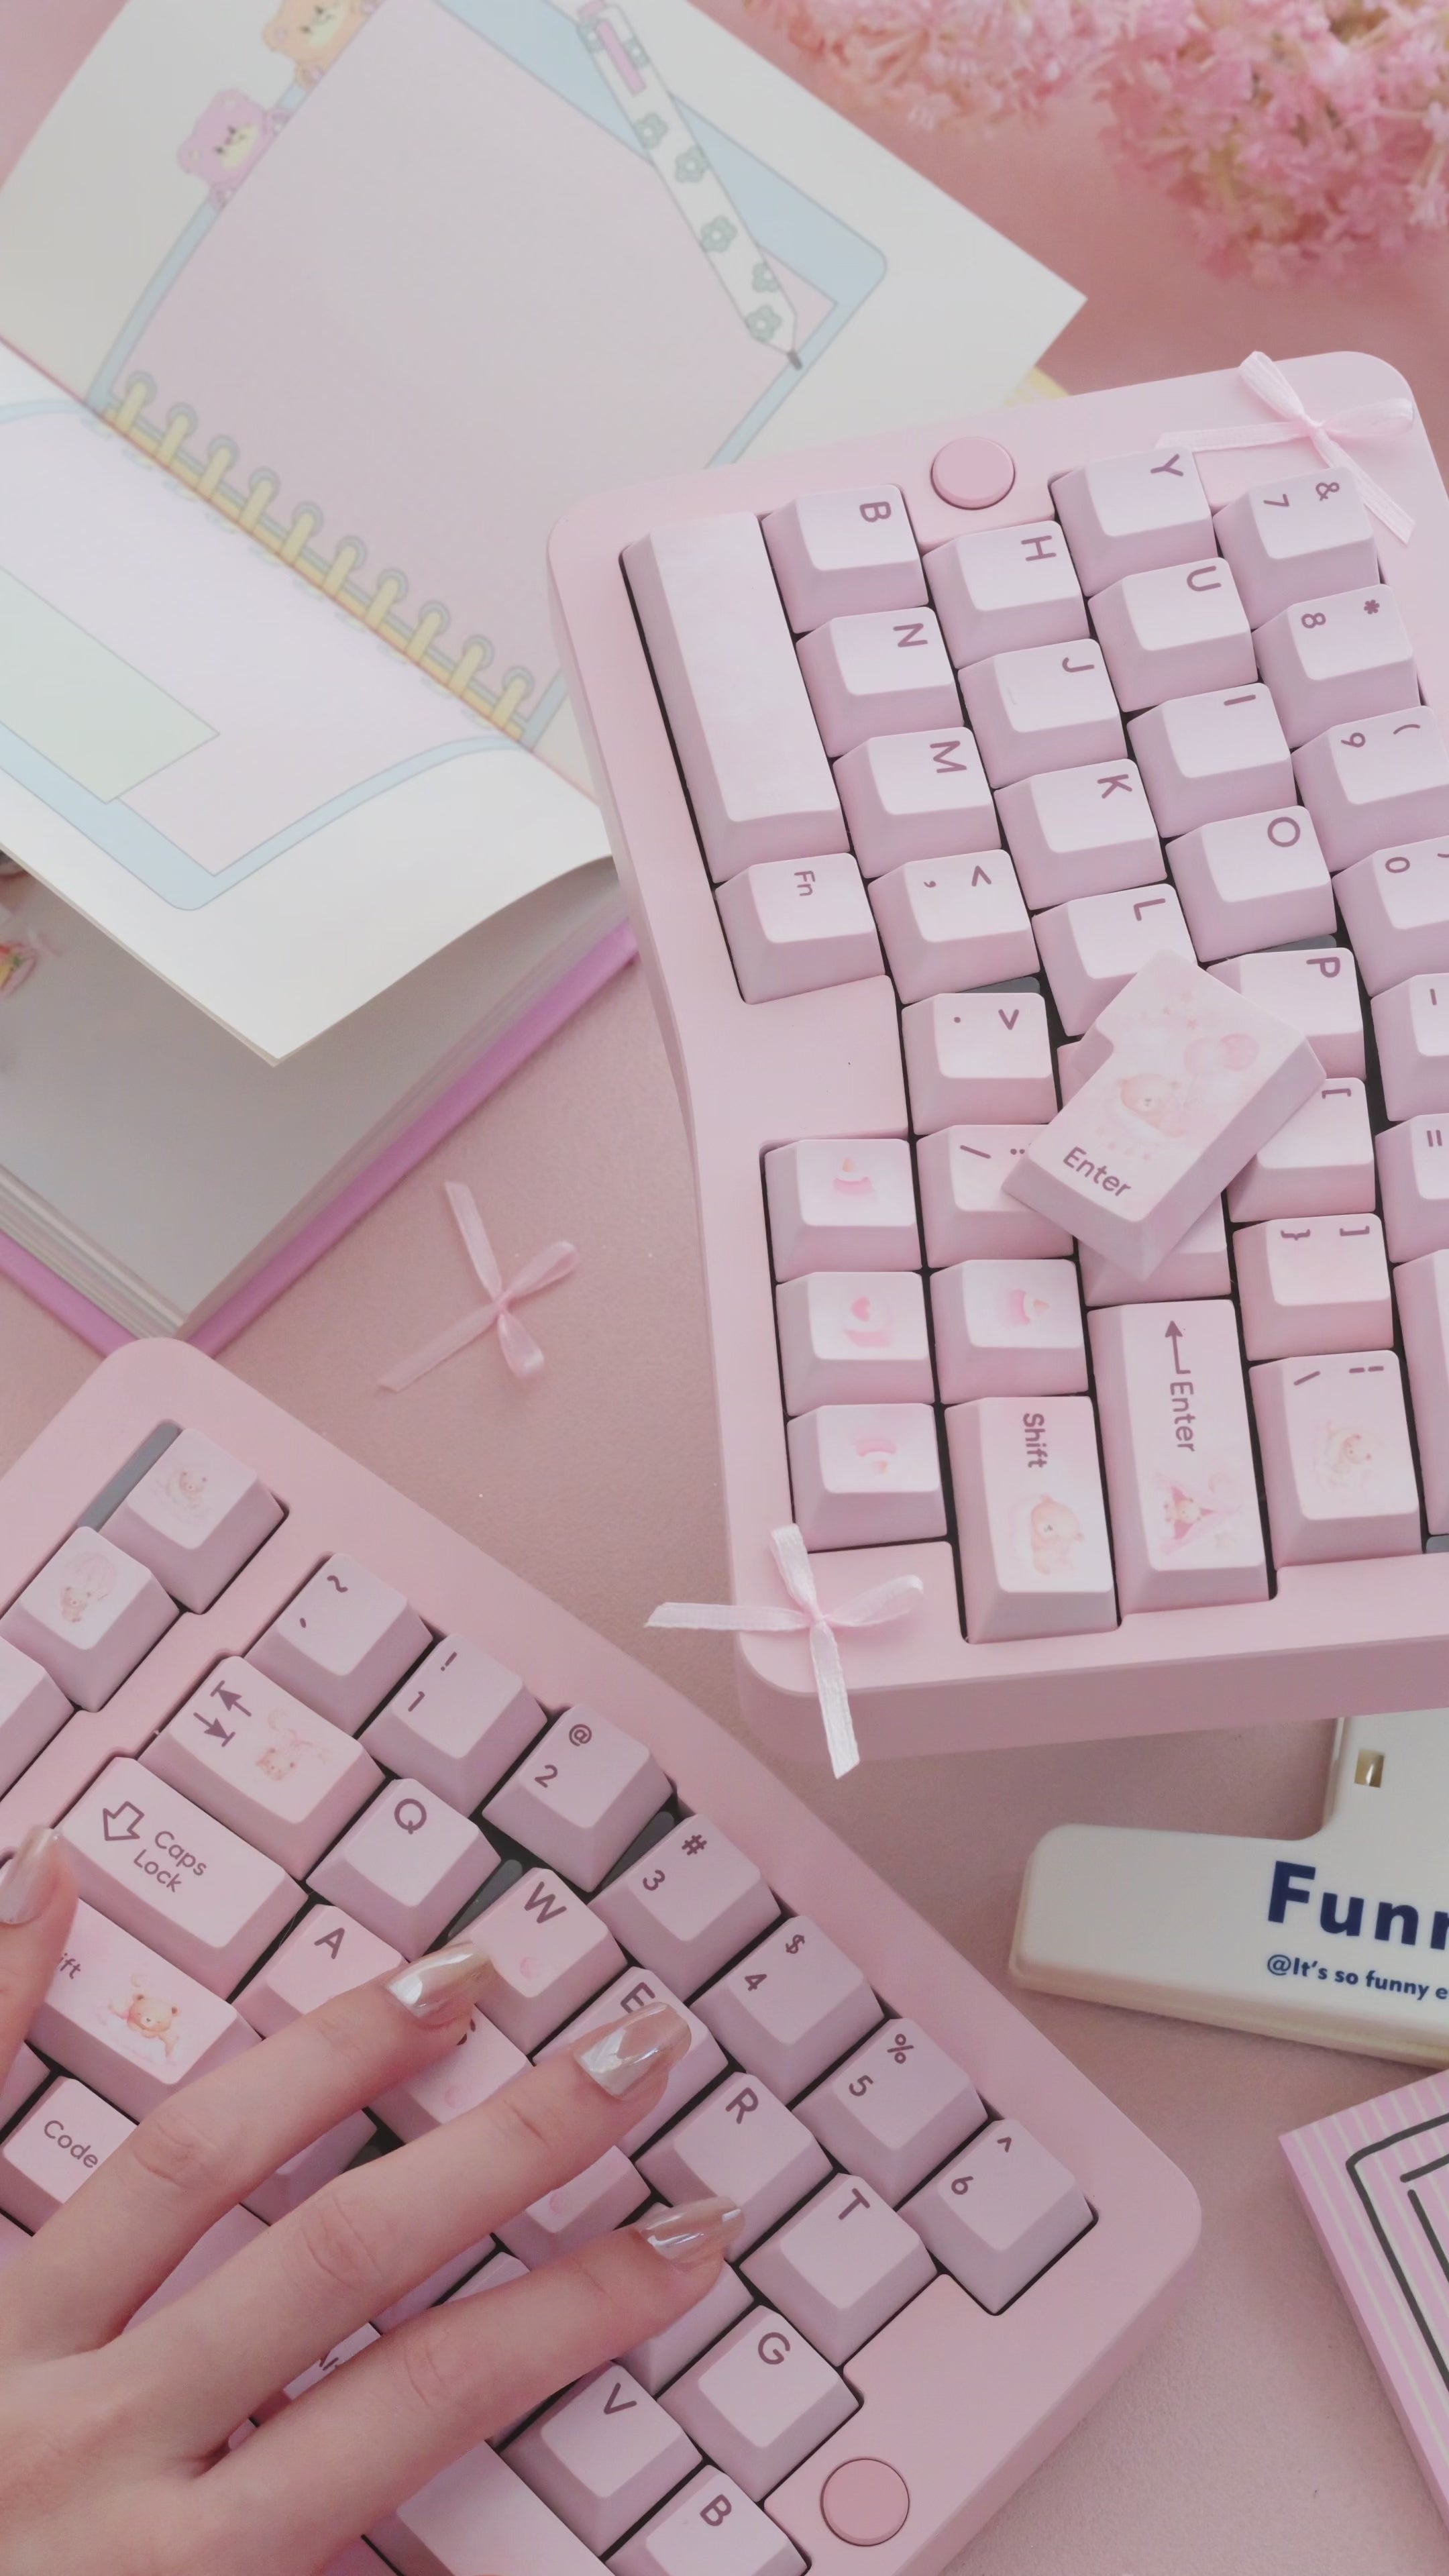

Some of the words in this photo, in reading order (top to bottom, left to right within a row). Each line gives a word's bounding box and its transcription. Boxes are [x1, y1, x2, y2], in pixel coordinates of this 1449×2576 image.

[1150, 453, 1184, 477] Y
[859, 501, 892, 523] B
[1263, 493, 1290, 507] 7
[1020, 535, 1057, 561] H
[1186, 566, 1222, 592] U
[1301, 612, 1326, 629] 8
[892, 623, 928, 648] N
[1061, 657, 1095, 673] J
[1340, 732, 1366, 748] 9
[929, 740, 967, 773] M
[1097, 773, 1133, 799] K
[1267, 816, 1301, 848] O
[794, 870, 816, 897] Fn
[1133, 898, 1166, 922] L
[1305, 956, 1341, 978] P
[1063, 1146, 1131, 1197] Enter
[1169, 1381, 1196, 1452] Enter
[1022, 1413, 1049, 1468] Shift
[407, 1690, 425, 1713] 1
[568, 1723, 592, 1747] @
[534, 1764, 558, 1788] 2
[394, 1798, 427, 1835] Q
[154, 1830, 207, 1877] Caps
[681, 1834, 708, 1856] #
[133, 1849, 182, 1893] Lock
[642, 1869, 665, 1891] 3
[524, 1881, 566, 1923] W
[313, 1927, 345, 1960] A
[785, 1934, 806, 1954] $
[59, 1953, 81, 1980] ift
[744, 1974, 767, 1992] 4
[1334, 1970, 1359, 1985] so
[1365, 1970, 1430, 2001] funny
[887, 2033, 914, 2065] %
[849, 2074, 874, 2097] 5
[725, 2087, 759, 2125] R
[44, 2120, 99, 2168] Code
[951, 2176, 974, 2196] 6
[838, 2188, 871, 2220] T
[757, 2332, 791, 2365] G
[603, 2383, 637, 2415] V
[699, 2493, 732, 2527] B
